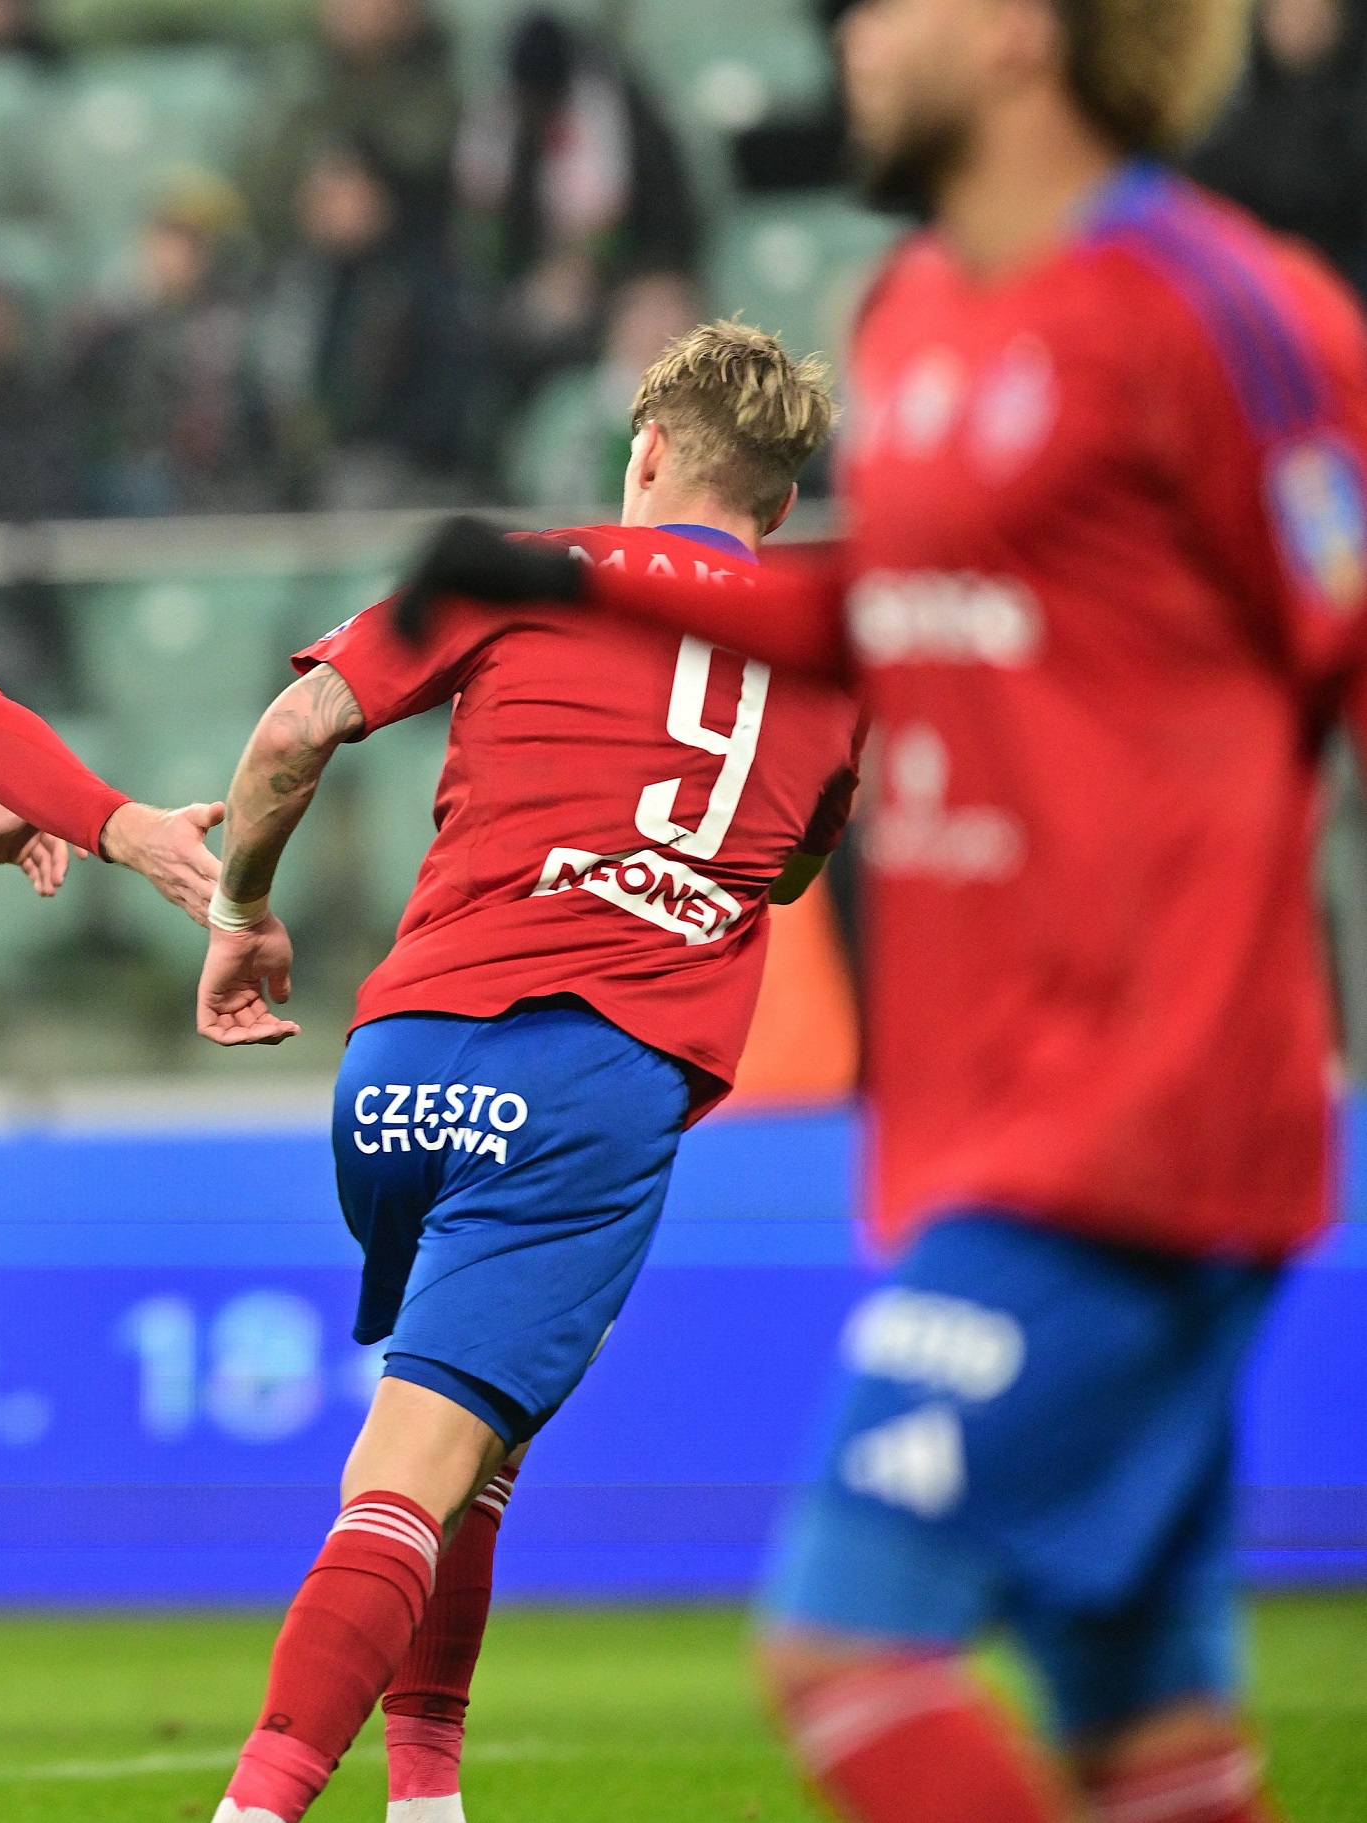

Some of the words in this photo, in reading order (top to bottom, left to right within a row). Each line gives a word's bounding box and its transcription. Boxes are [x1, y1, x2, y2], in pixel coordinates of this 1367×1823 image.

[569, 545, 756, 588] MAK
[634, 632, 772, 861] 9
[548, 859, 732, 938] NEONET
[354, 1083, 528, 1132] CZĘSTO
